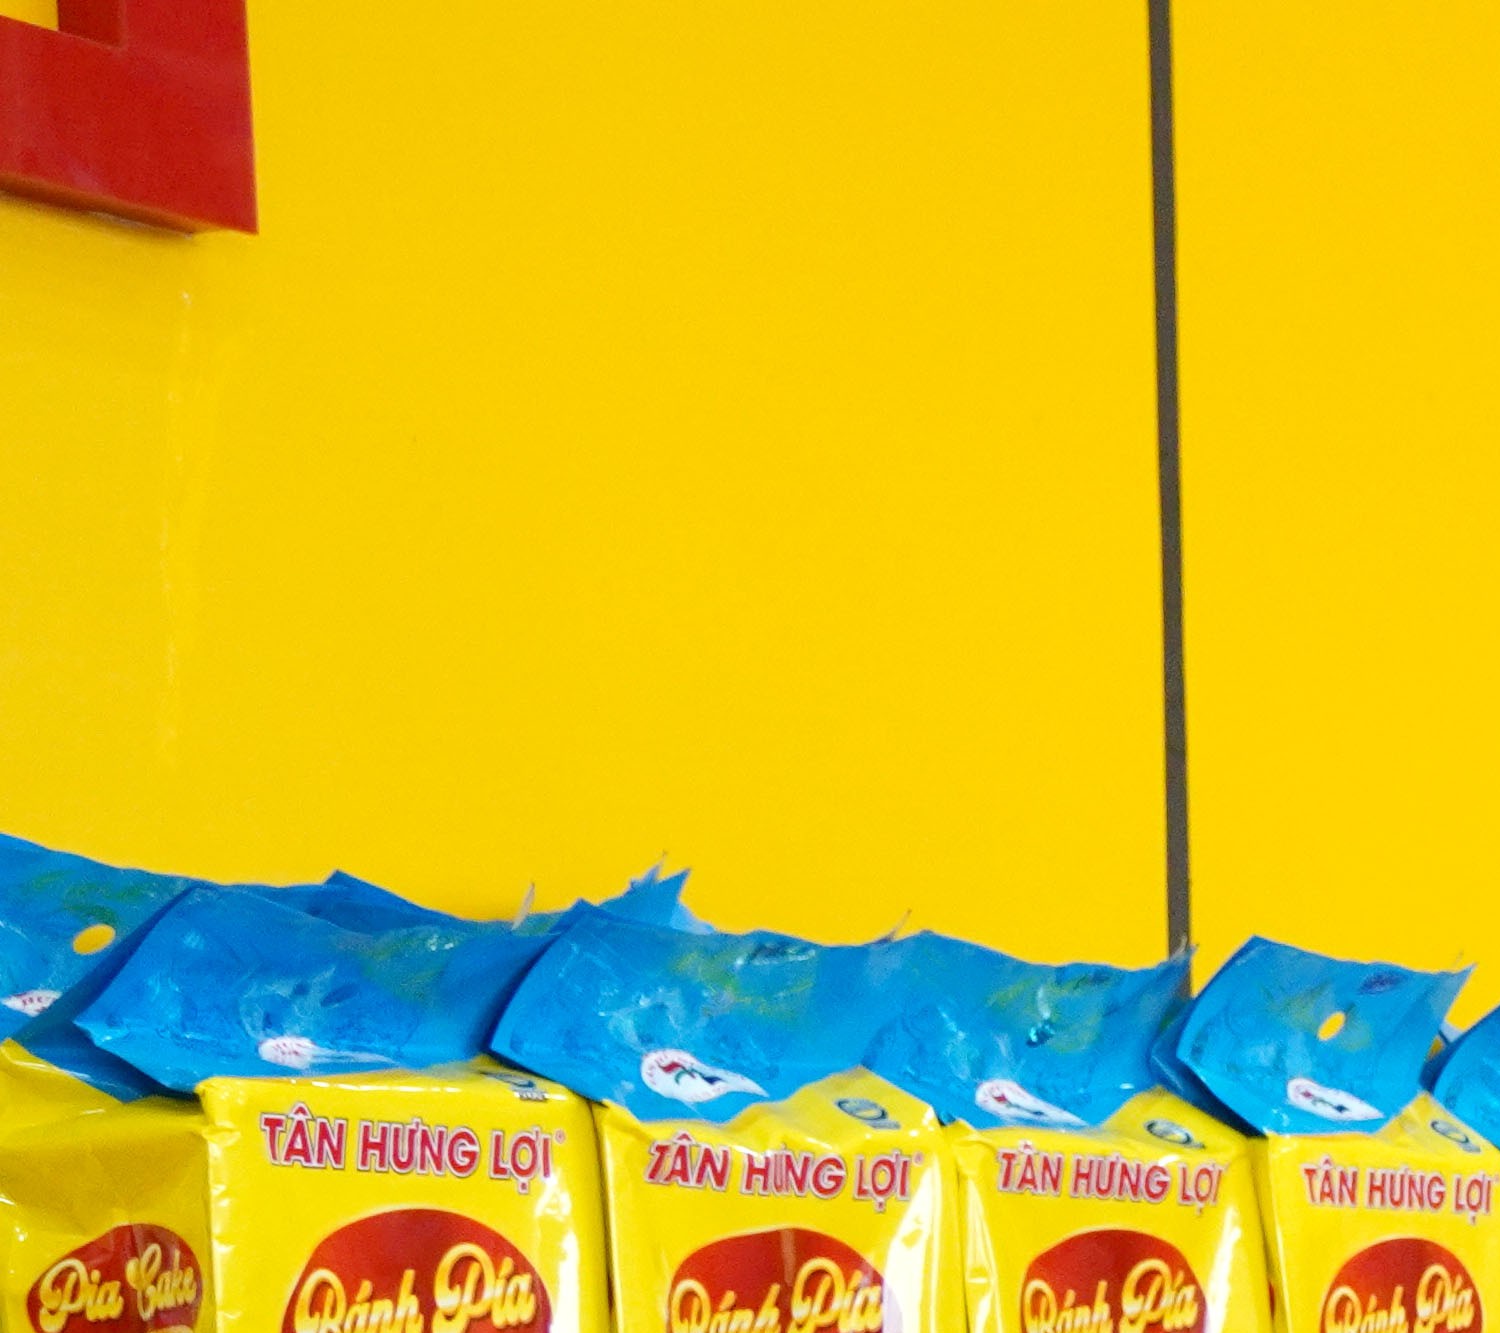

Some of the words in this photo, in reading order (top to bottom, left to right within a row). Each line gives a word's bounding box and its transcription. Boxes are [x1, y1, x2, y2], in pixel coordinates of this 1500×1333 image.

[261, 1102, 347, 1171] TÂN
[358, 1121, 480, 1178] HƯNG
[487, 1129, 553, 1195] LỢI
[646, 1132, 731, 1190] TÂN
[854, 1150, 912, 1214] LỢI
[997, 1143, 1062, 1197] TÂN
[1070, 1152, 1171, 1202] HƯNG
[1177, 1164, 1222, 1216] LỢI
[1302, 1157, 1358, 1210] TÂN
[1365, 1169, 1447, 1212] HƯNG
[1453, 1174, 1493, 1231] LỢI
